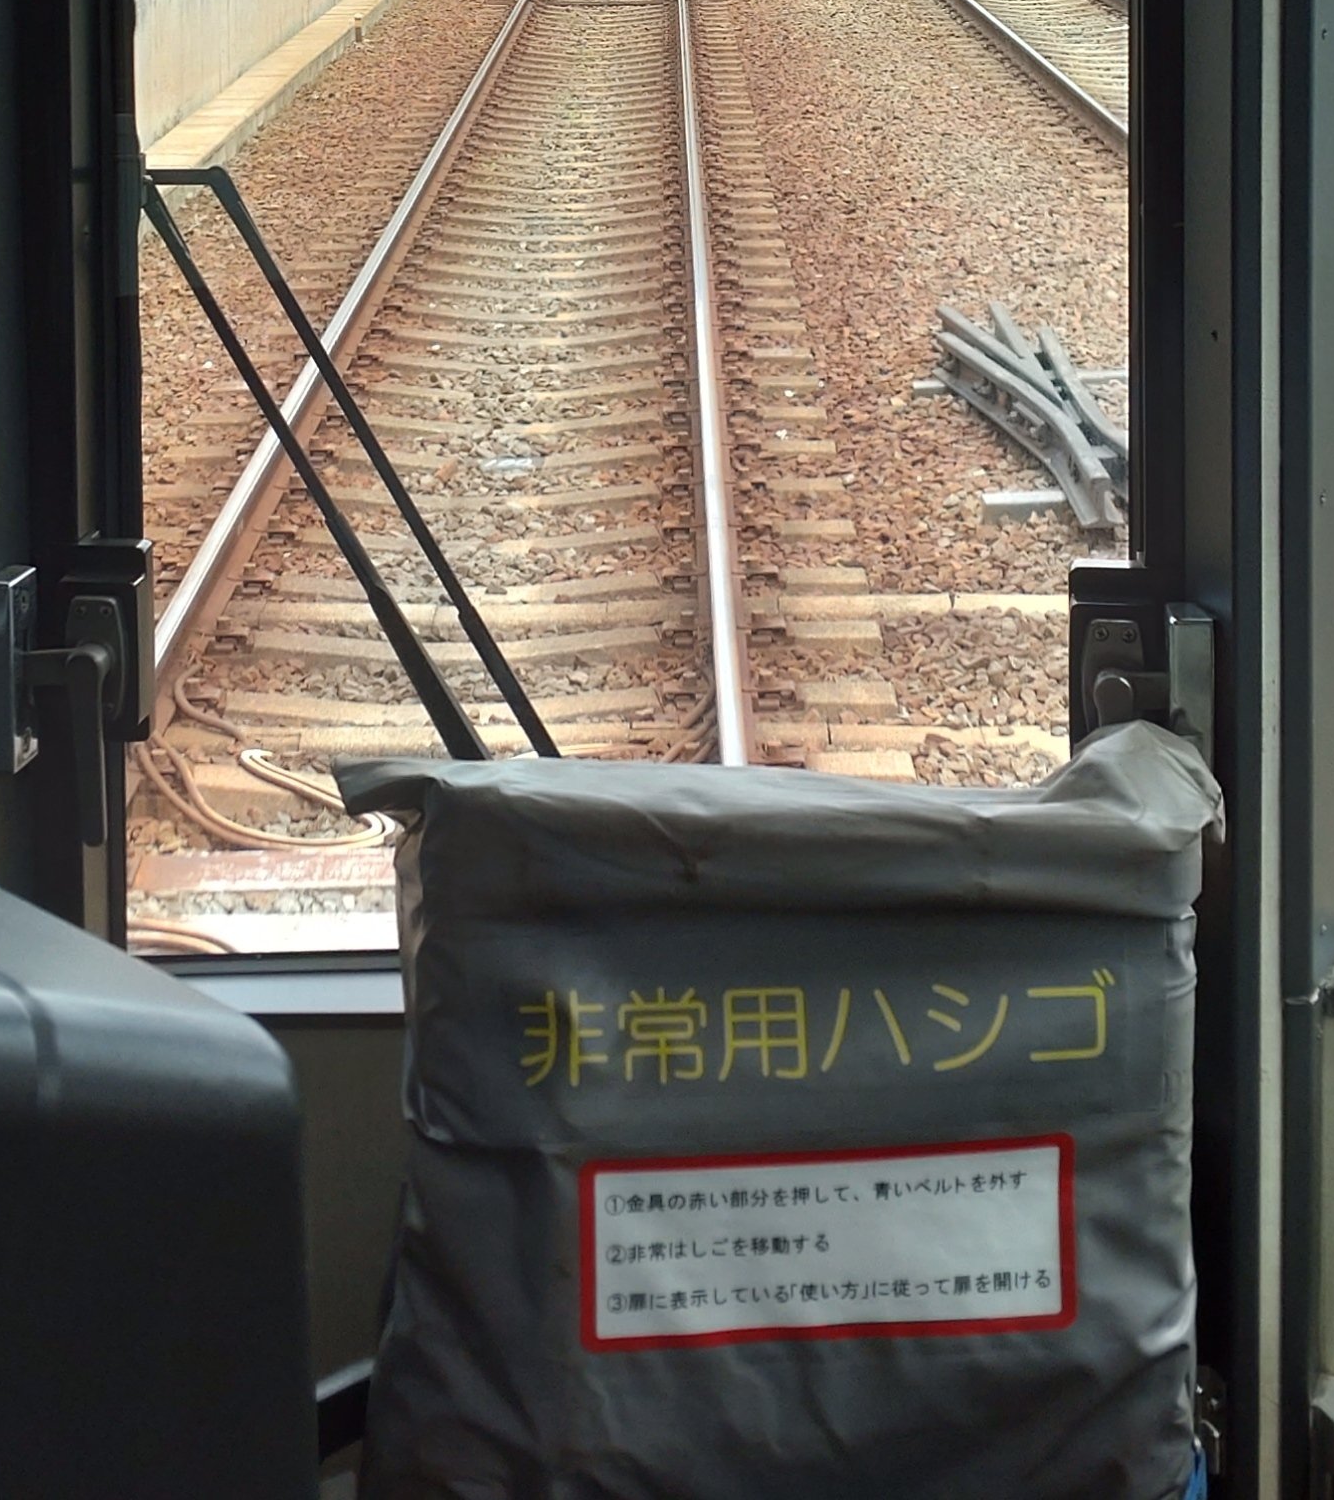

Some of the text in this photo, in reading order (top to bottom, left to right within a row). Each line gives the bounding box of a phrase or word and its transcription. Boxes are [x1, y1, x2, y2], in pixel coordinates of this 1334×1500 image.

[518, 968, 1115, 1088] 非常用ハシゴ
[605, 1233, 830, 1265] ②非常はしごを移動する
